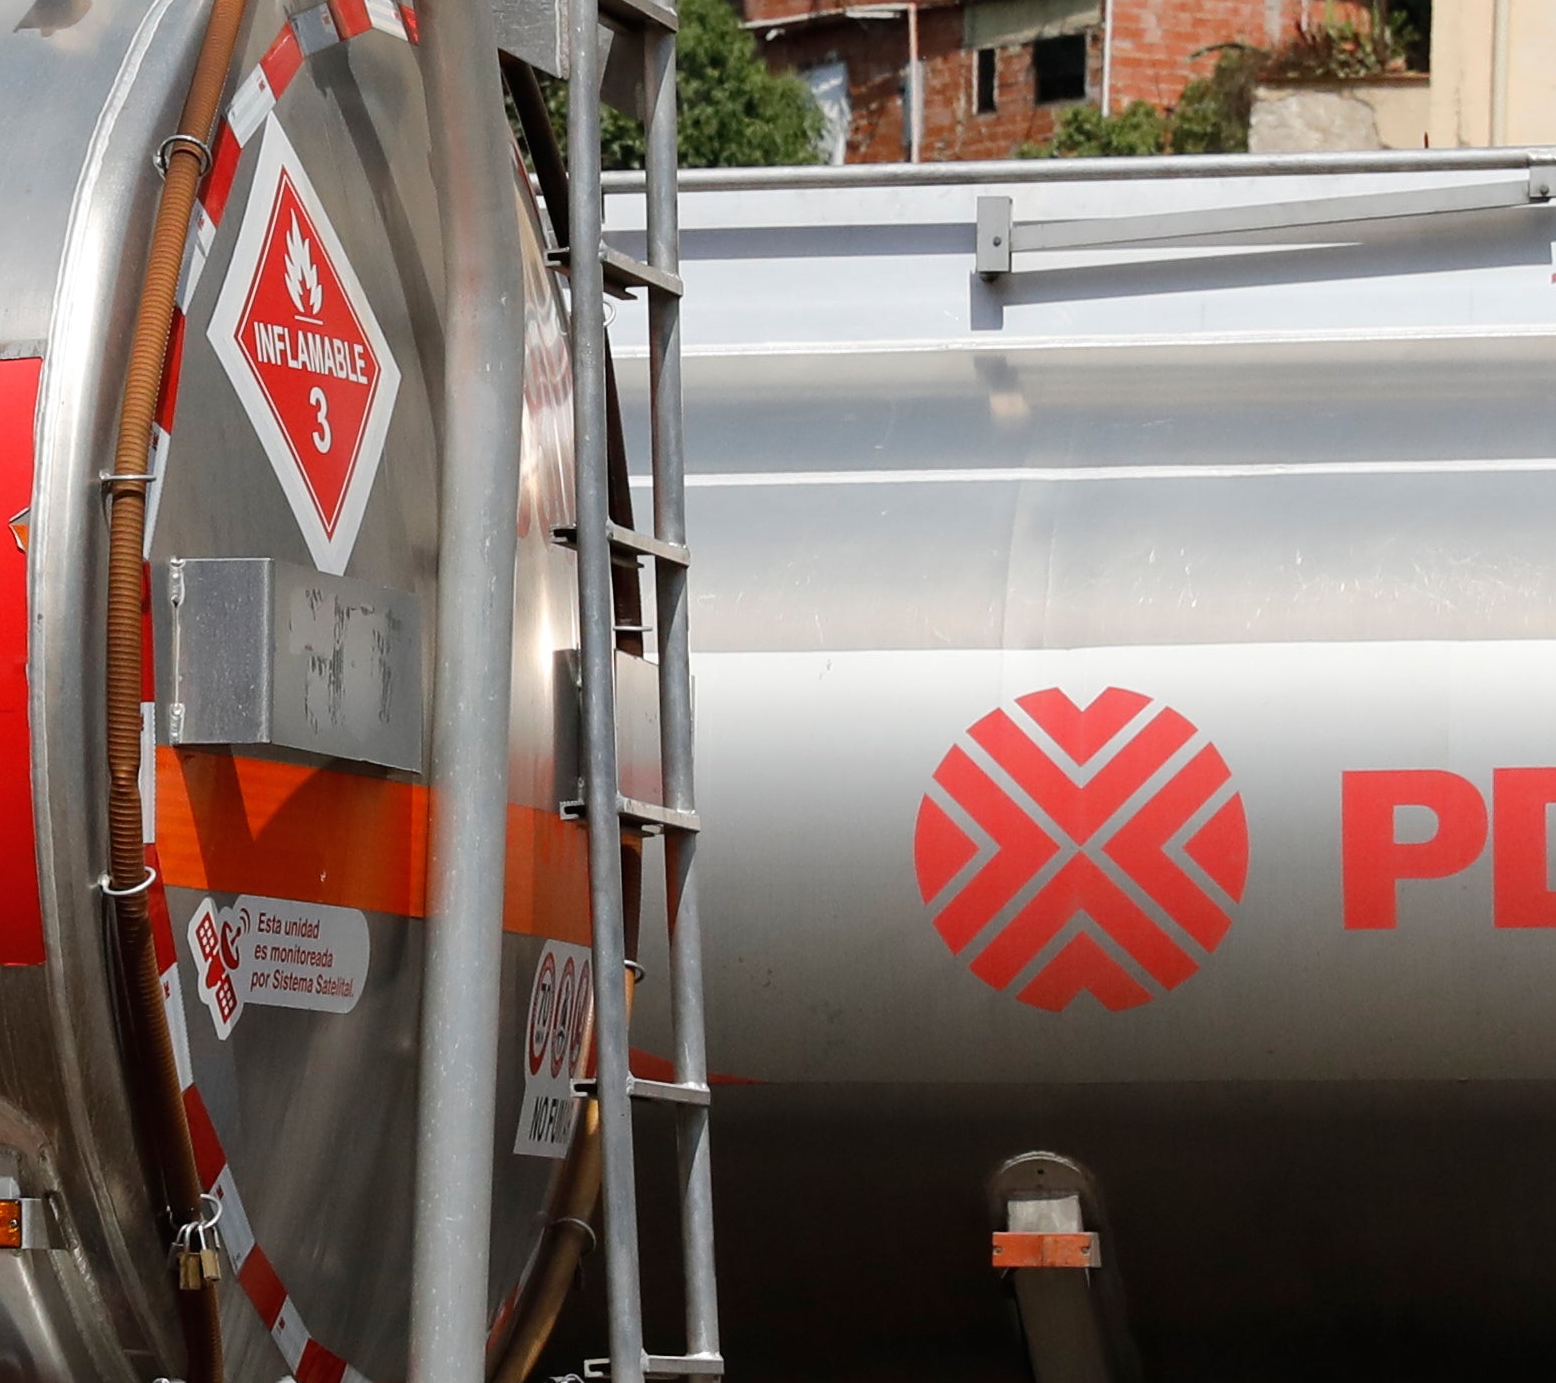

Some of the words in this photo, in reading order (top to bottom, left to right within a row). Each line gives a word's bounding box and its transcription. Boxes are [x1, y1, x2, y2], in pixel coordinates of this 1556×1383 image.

[253, 321, 369, 385] INFLAMABLE
[309, 386, 332, 454] 3
[257, 912, 282, 935] Esta
[284, 920, 321, 940] unidad
[254, 944, 268, 961] es
[270, 945, 333, 968] monitoreada
[250, 970, 271, 992] por
[272, 970, 314, 994] Sistema
